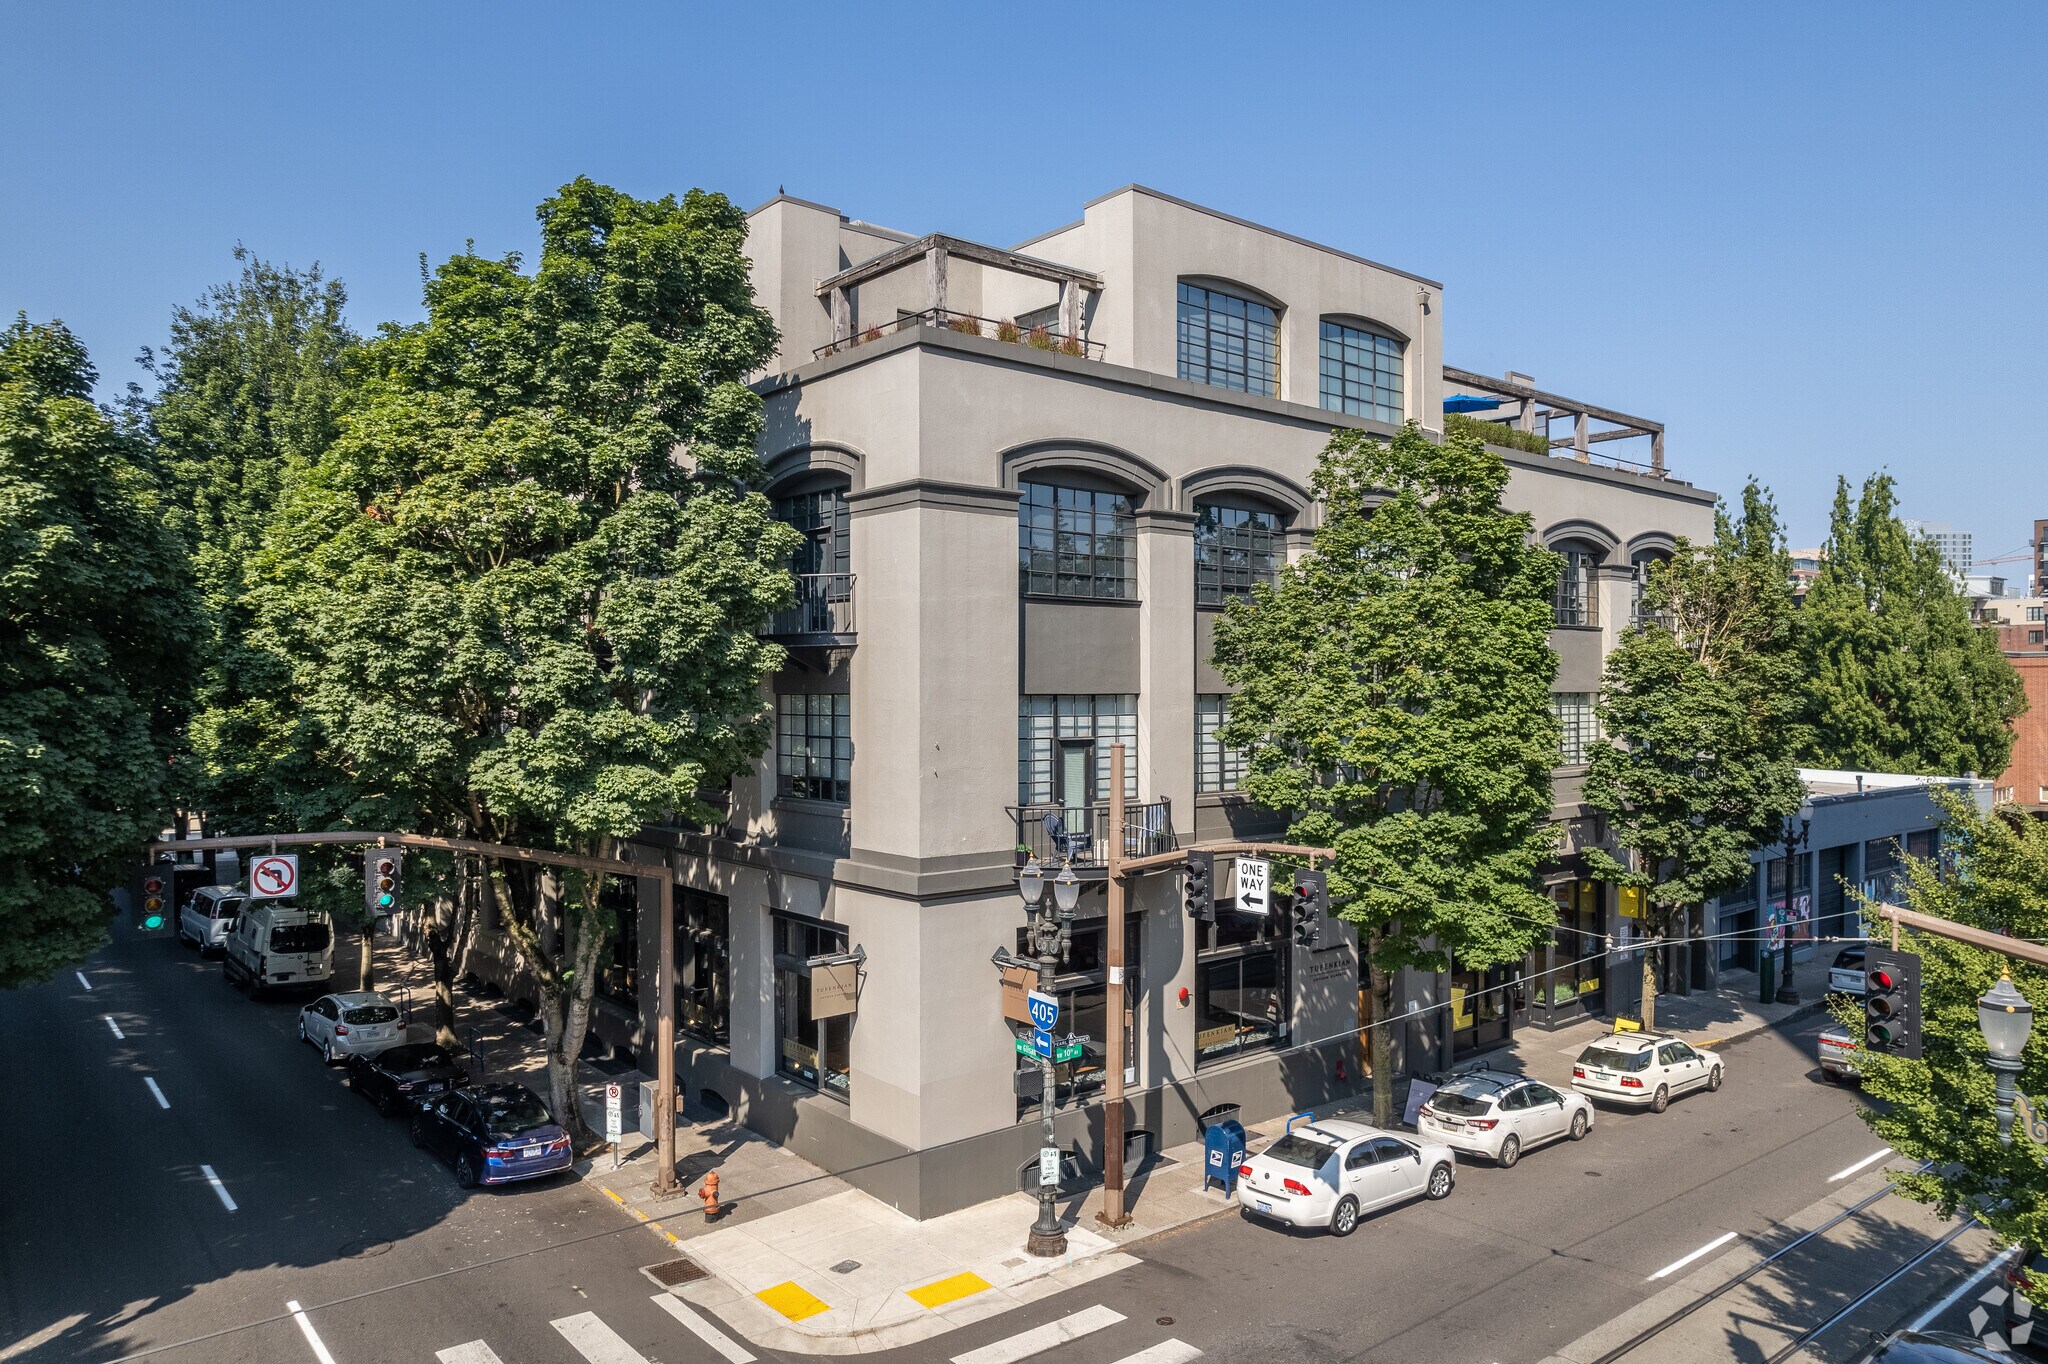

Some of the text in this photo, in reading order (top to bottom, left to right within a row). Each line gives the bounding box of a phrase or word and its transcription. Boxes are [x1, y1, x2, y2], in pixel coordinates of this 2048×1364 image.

[1241, 863, 1263, 877] ONE
[1240, 876, 1264, 891] WAY
[1309, 958, 1351, 973] TUFENKIAN
[1032, 1002, 1054, 1024] 405
[1199, 1026, 1233, 1039] UFENKIAN
